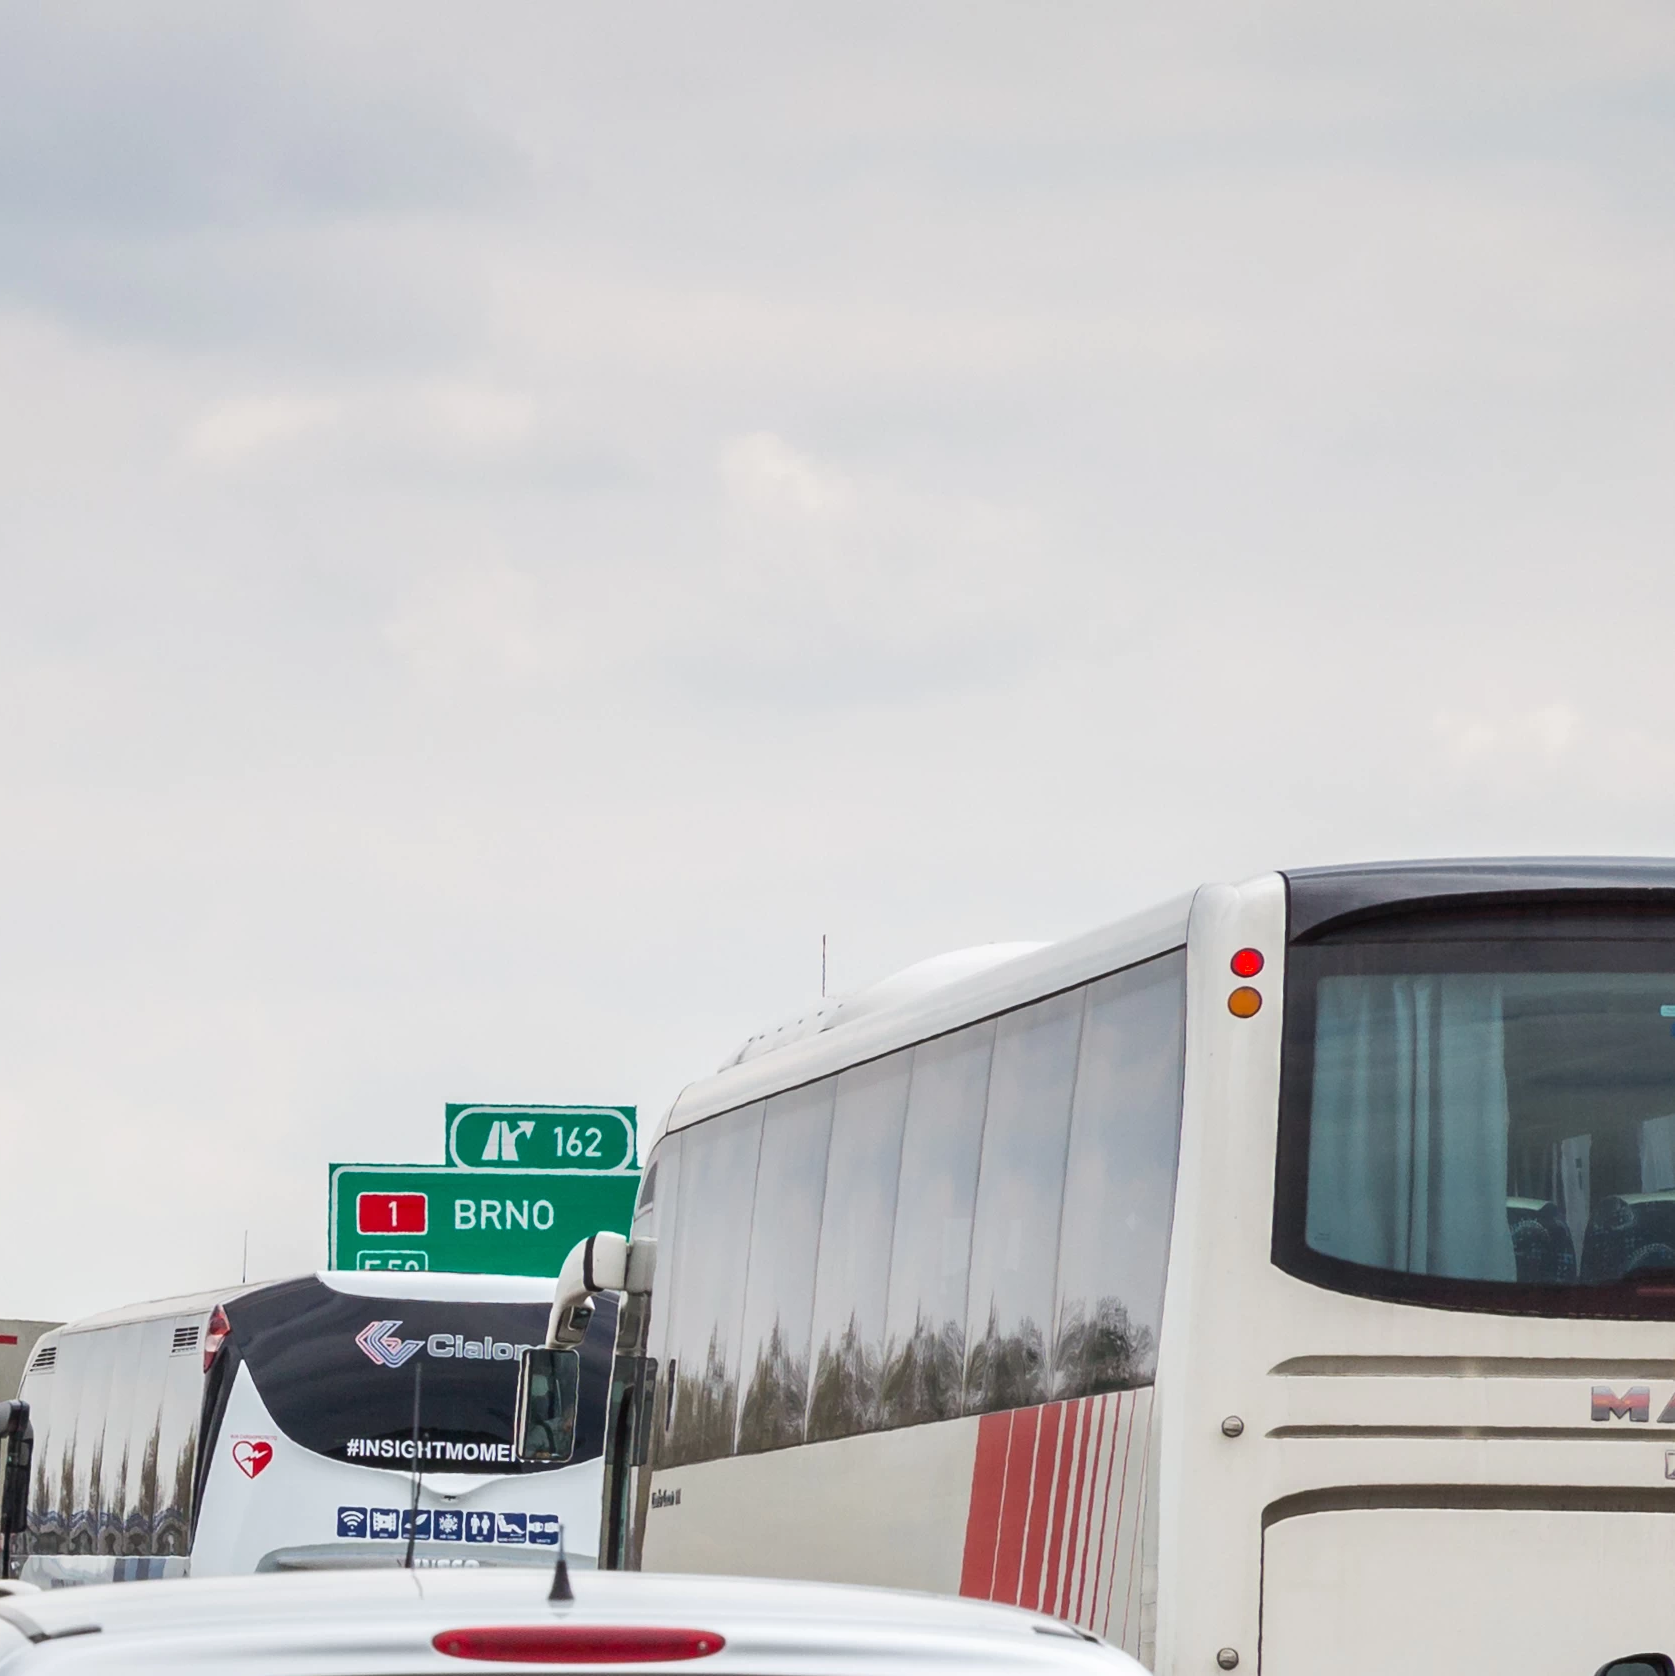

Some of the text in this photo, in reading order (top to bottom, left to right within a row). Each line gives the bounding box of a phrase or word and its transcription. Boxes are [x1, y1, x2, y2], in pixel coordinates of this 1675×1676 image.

[553, 1126, 603, 1158] 162
[387, 1200, 398, 1227] 1
[454, 1199, 555, 1230] BRNO
[1591, 1385, 1675, 1423] M
[346, 1438, 551, 1463] #INSIGHTMOME
